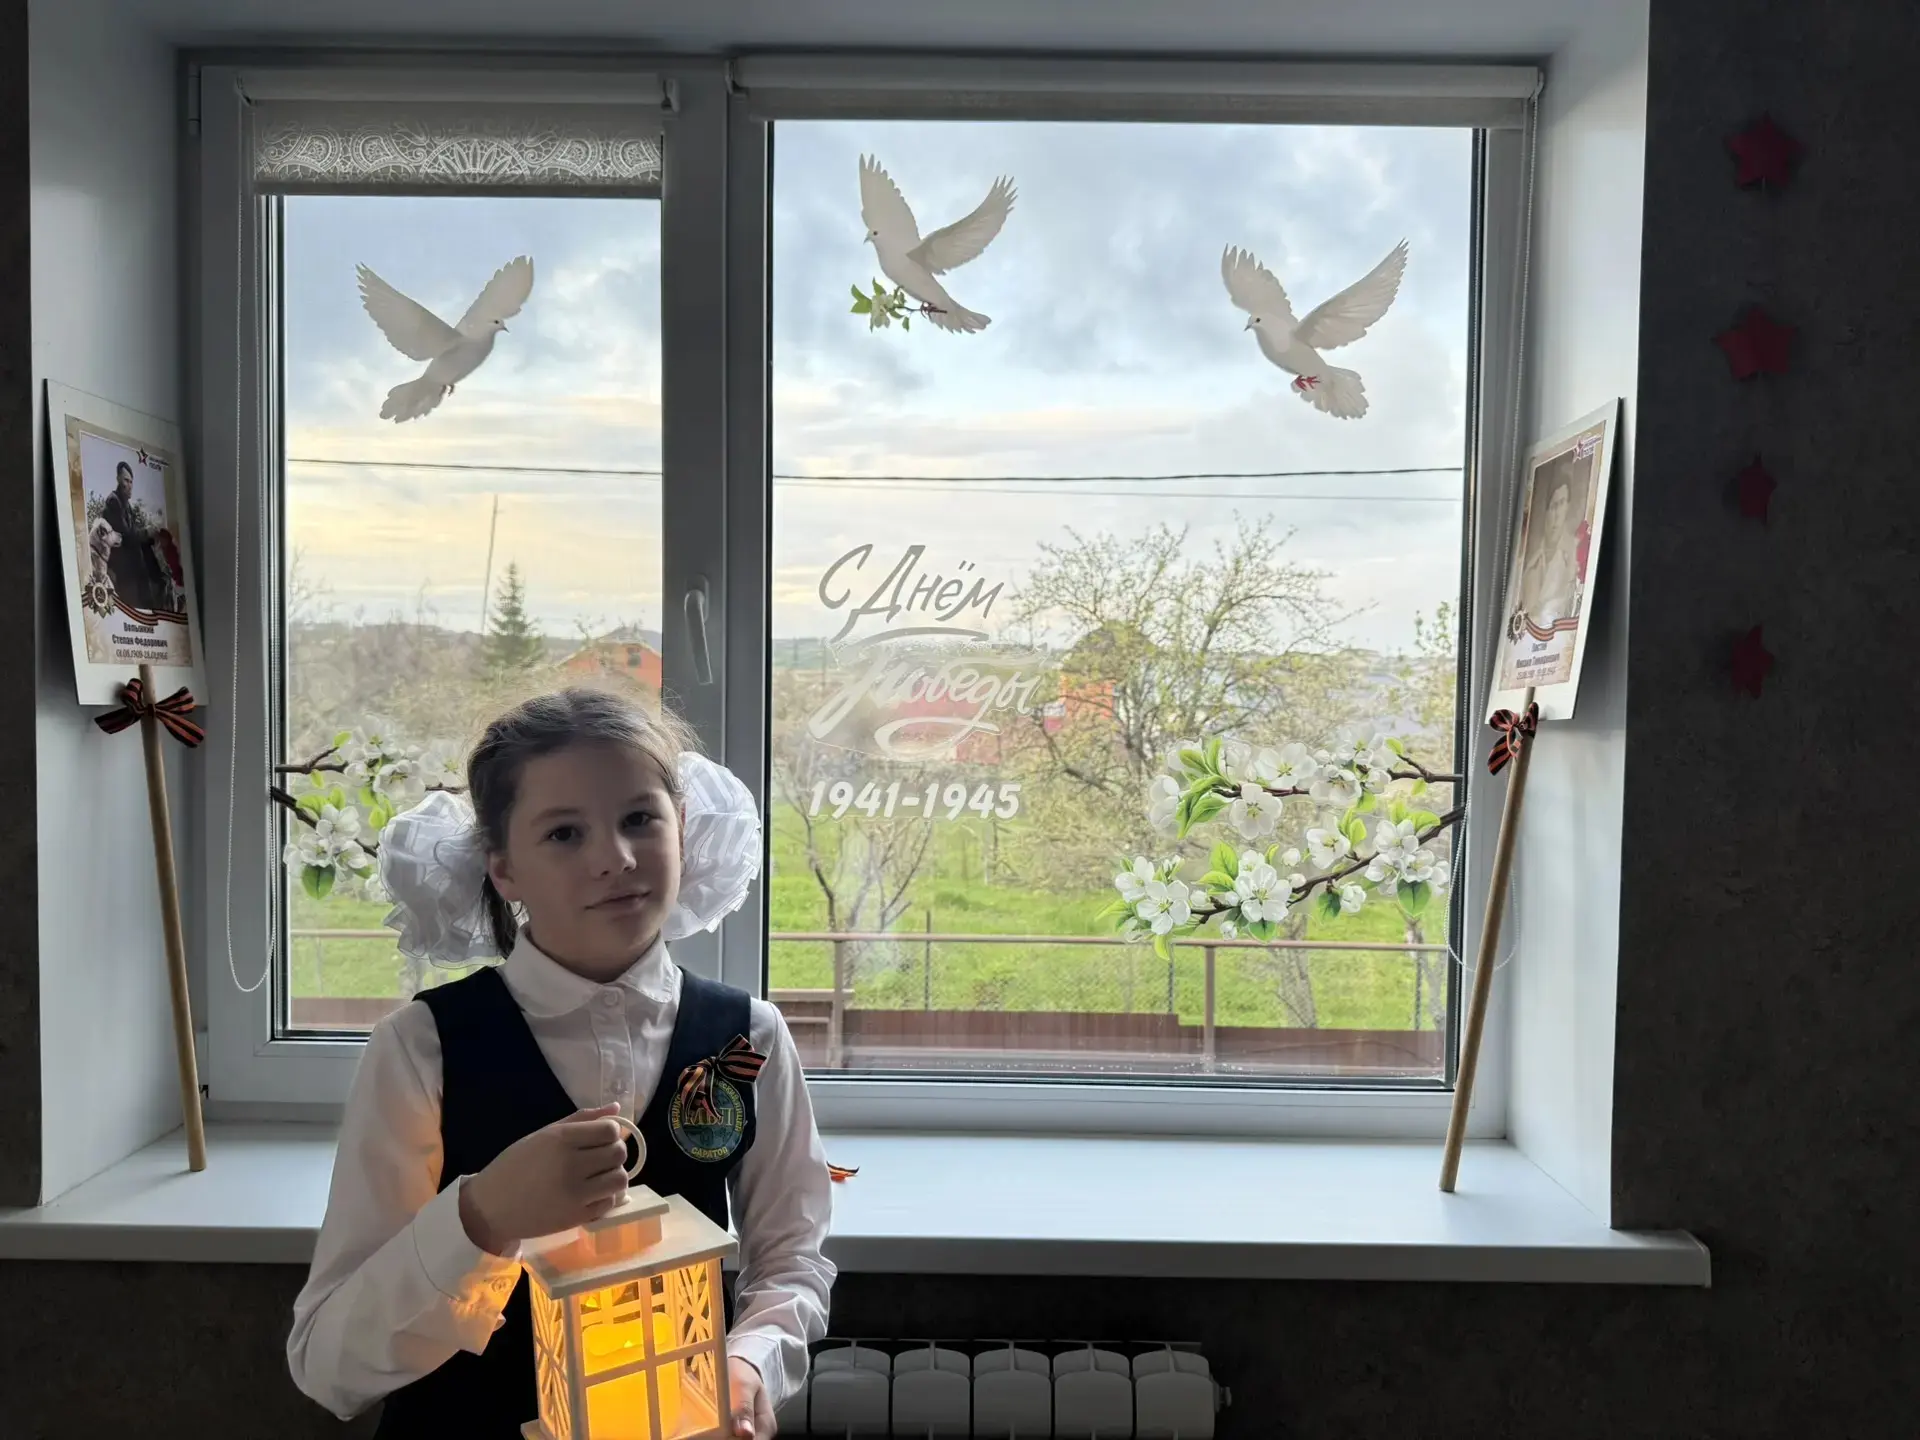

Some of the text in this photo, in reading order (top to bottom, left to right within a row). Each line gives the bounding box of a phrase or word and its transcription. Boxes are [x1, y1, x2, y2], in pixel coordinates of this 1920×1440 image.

[819, 544, 1004, 644] С Днём
[808, 781, 1021, 820] 1941-1945
[691, 1146, 728, 1158] САРАТОВ
